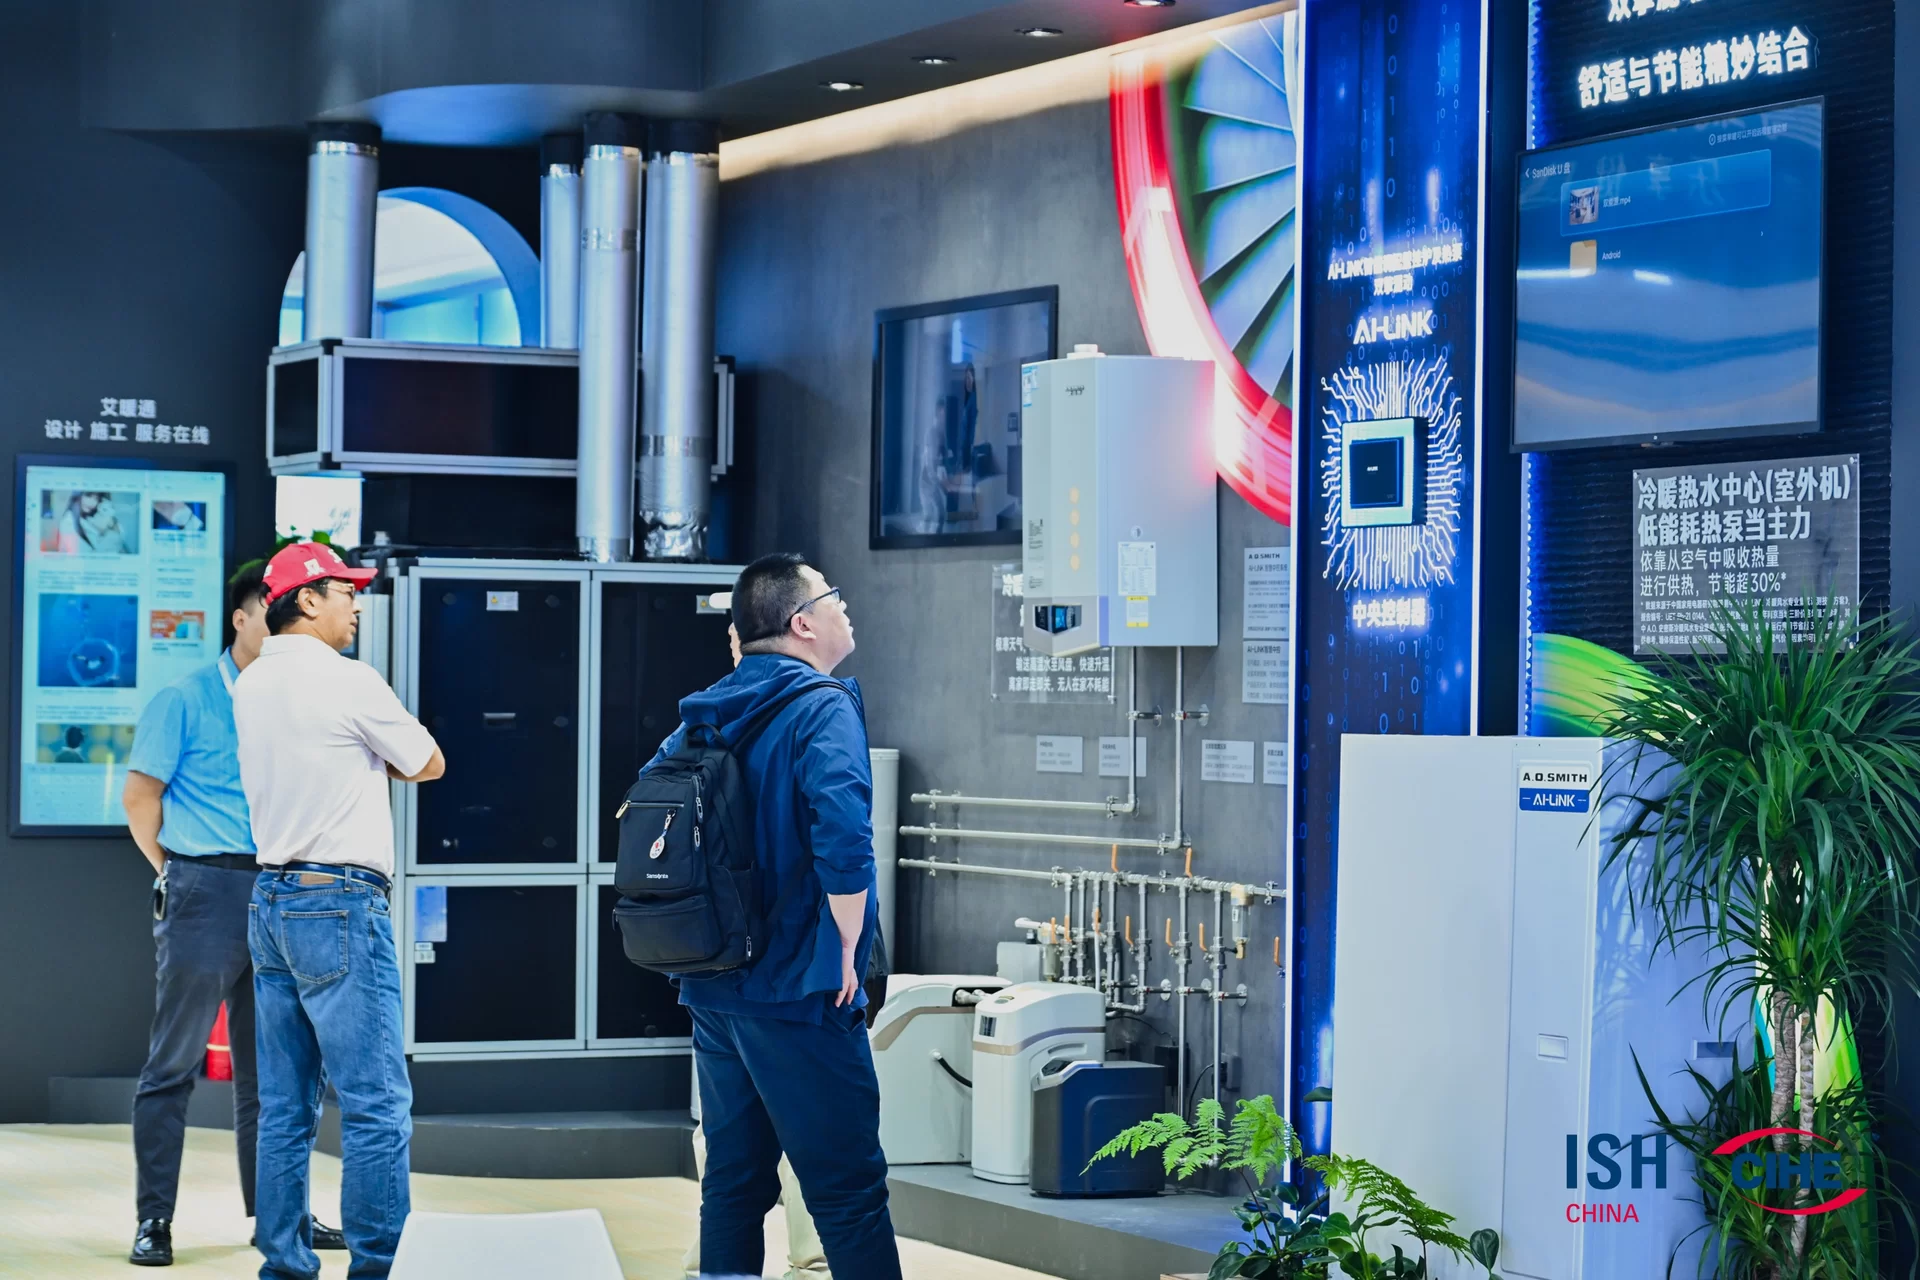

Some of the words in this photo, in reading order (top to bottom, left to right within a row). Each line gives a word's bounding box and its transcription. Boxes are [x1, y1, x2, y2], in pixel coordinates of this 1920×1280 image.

[1578, 26, 1809, 108] 舒适与节能精妙结合
[1532, 166, 1557, 179] SanDisk
[1557, 164, 1563, 174] U
[1602, 250, 1621, 261] Android
[100, 397, 158, 419] 艾暖通
[44, 419, 83, 440] 设计
[90, 421, 129, 441] 施工
[135, 423, 210, 446] 服务在线
[1638, 464, 1851, 511] 冷暖热水中心(室外机)
[1638, 504, 1811, 547] 低能耗热泵当主力
[1640, 545, 1780, 573] 依靠从空气中吸收热量
[1522, 772, 1588, 783] A.O.SMITH
